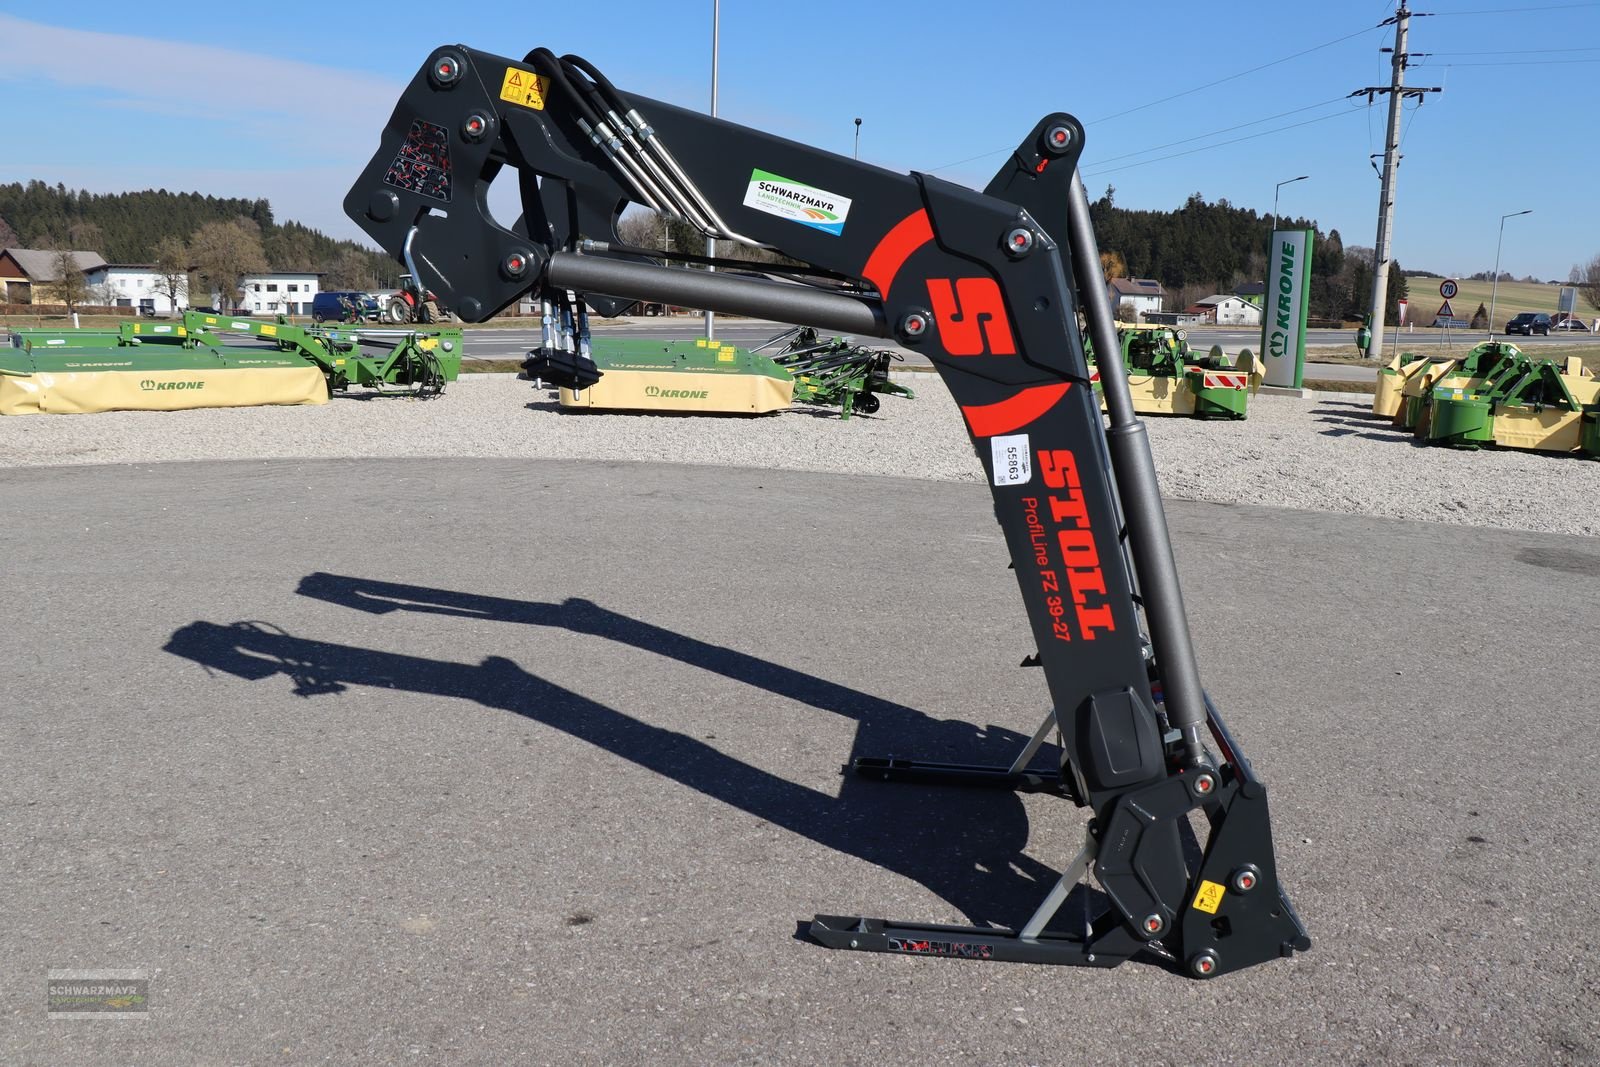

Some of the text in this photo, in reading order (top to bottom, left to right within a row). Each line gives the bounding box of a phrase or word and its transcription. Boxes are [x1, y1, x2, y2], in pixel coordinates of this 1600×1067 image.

[757, 191, 801, 210] LANDTECHNIK
[758, 181, 834, 212] SCHWARZMAYR
[1277, 241, 1295, 330] KRONE
[1443, 284, 1454, 295] 70
[156, 381, 205, 391] KRONE
[660, 389, 709, 399] KRONE
[1007, 446, 1019, 480] 55863
[1037, 449, 1116, 640] STOLL
[1021, 497, 1071, 642] ProfiLine FZ 39-27
